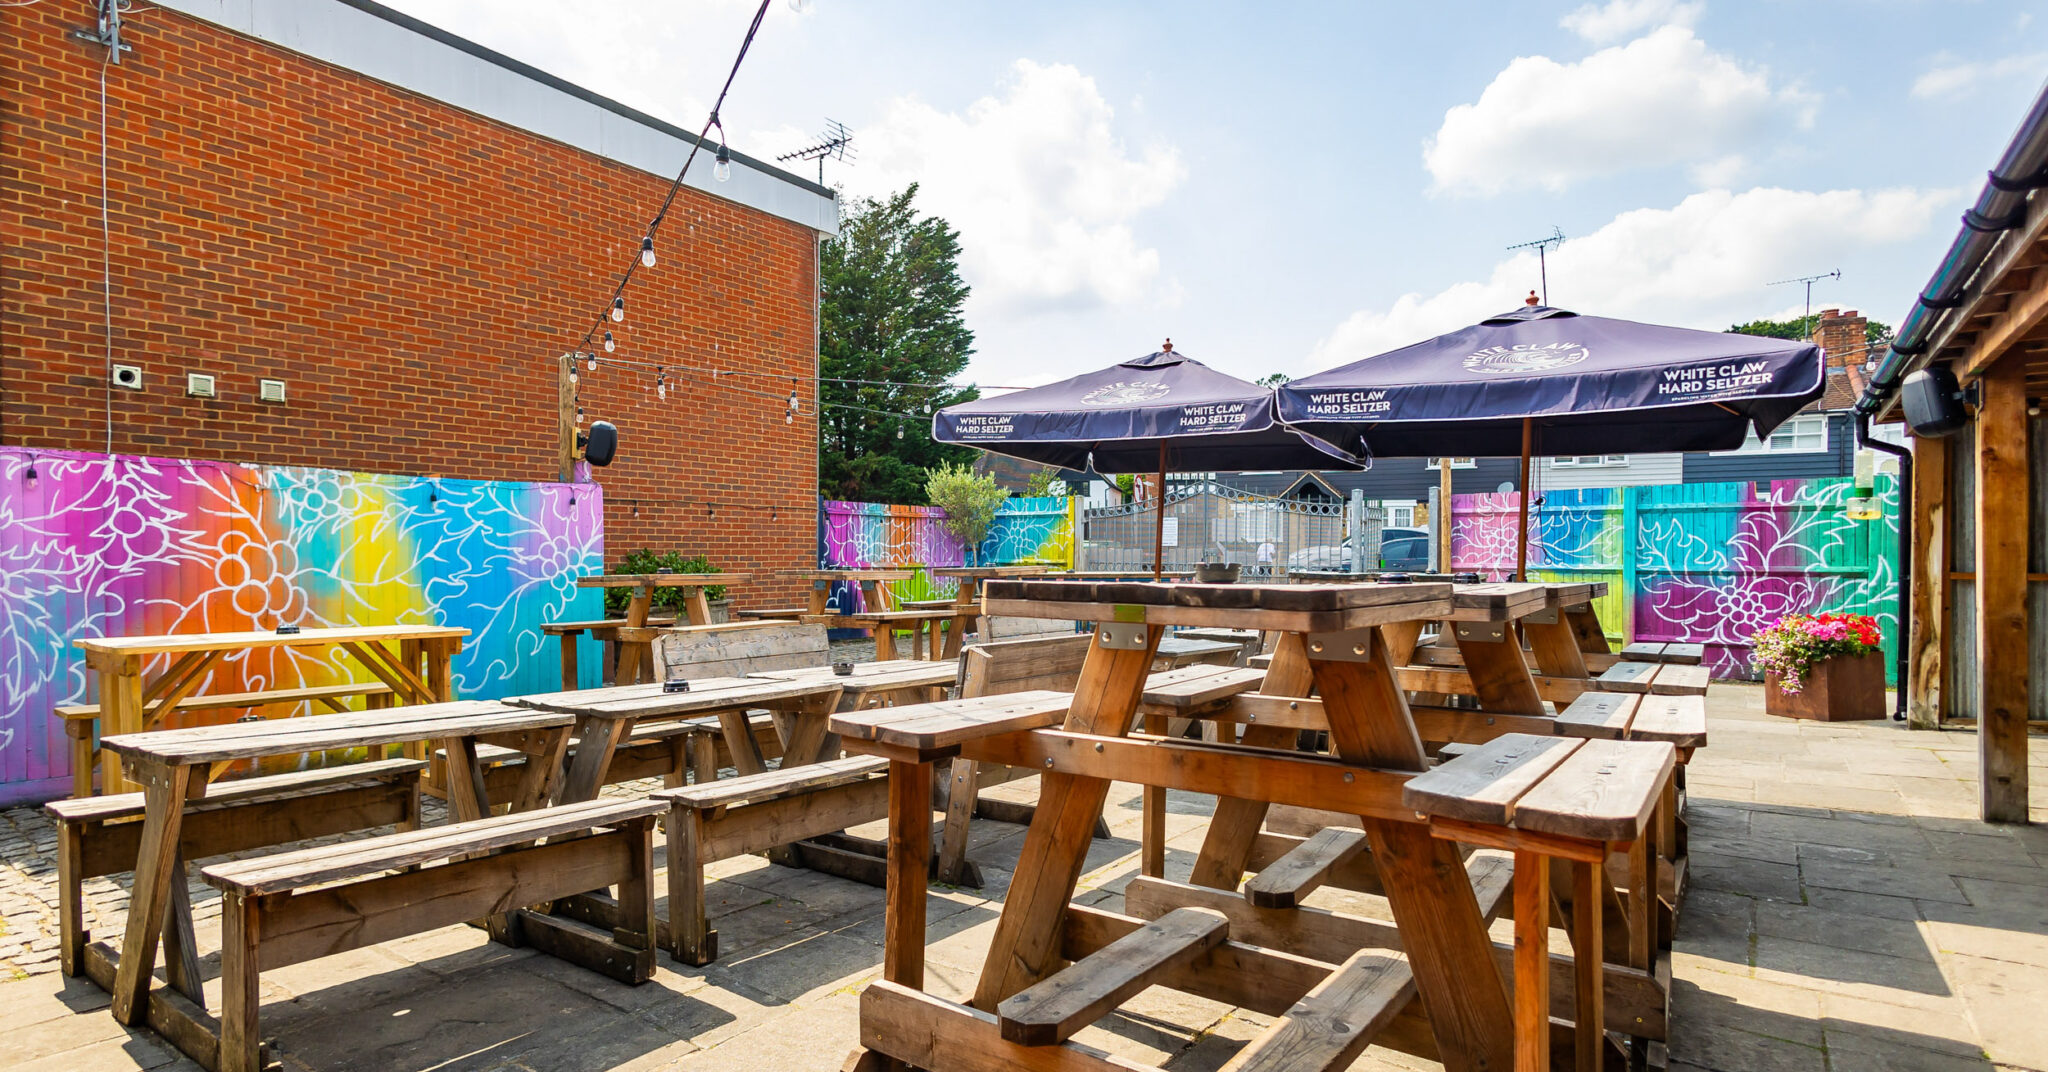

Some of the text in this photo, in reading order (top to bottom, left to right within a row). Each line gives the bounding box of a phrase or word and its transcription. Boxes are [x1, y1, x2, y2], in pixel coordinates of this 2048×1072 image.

[1512, 342, 1581, 351] CLAW
[1664, 361, 1768, 381] WHITE CLAW
[1659, 373, 1773, 394] HARD SELTZER
[1310, 391, 1387, 404] WHITE CLAW
[1184, 404, 1245, 416] WHITE CLAW
[1307, 401, 1391, 414] HARD SELTZER
[960, 416, 1012, 425] WHITE CLAW
[1180, 413, 1246, 426] HARD SELTZER
[981, 425, 1014, 433] SELTZER
